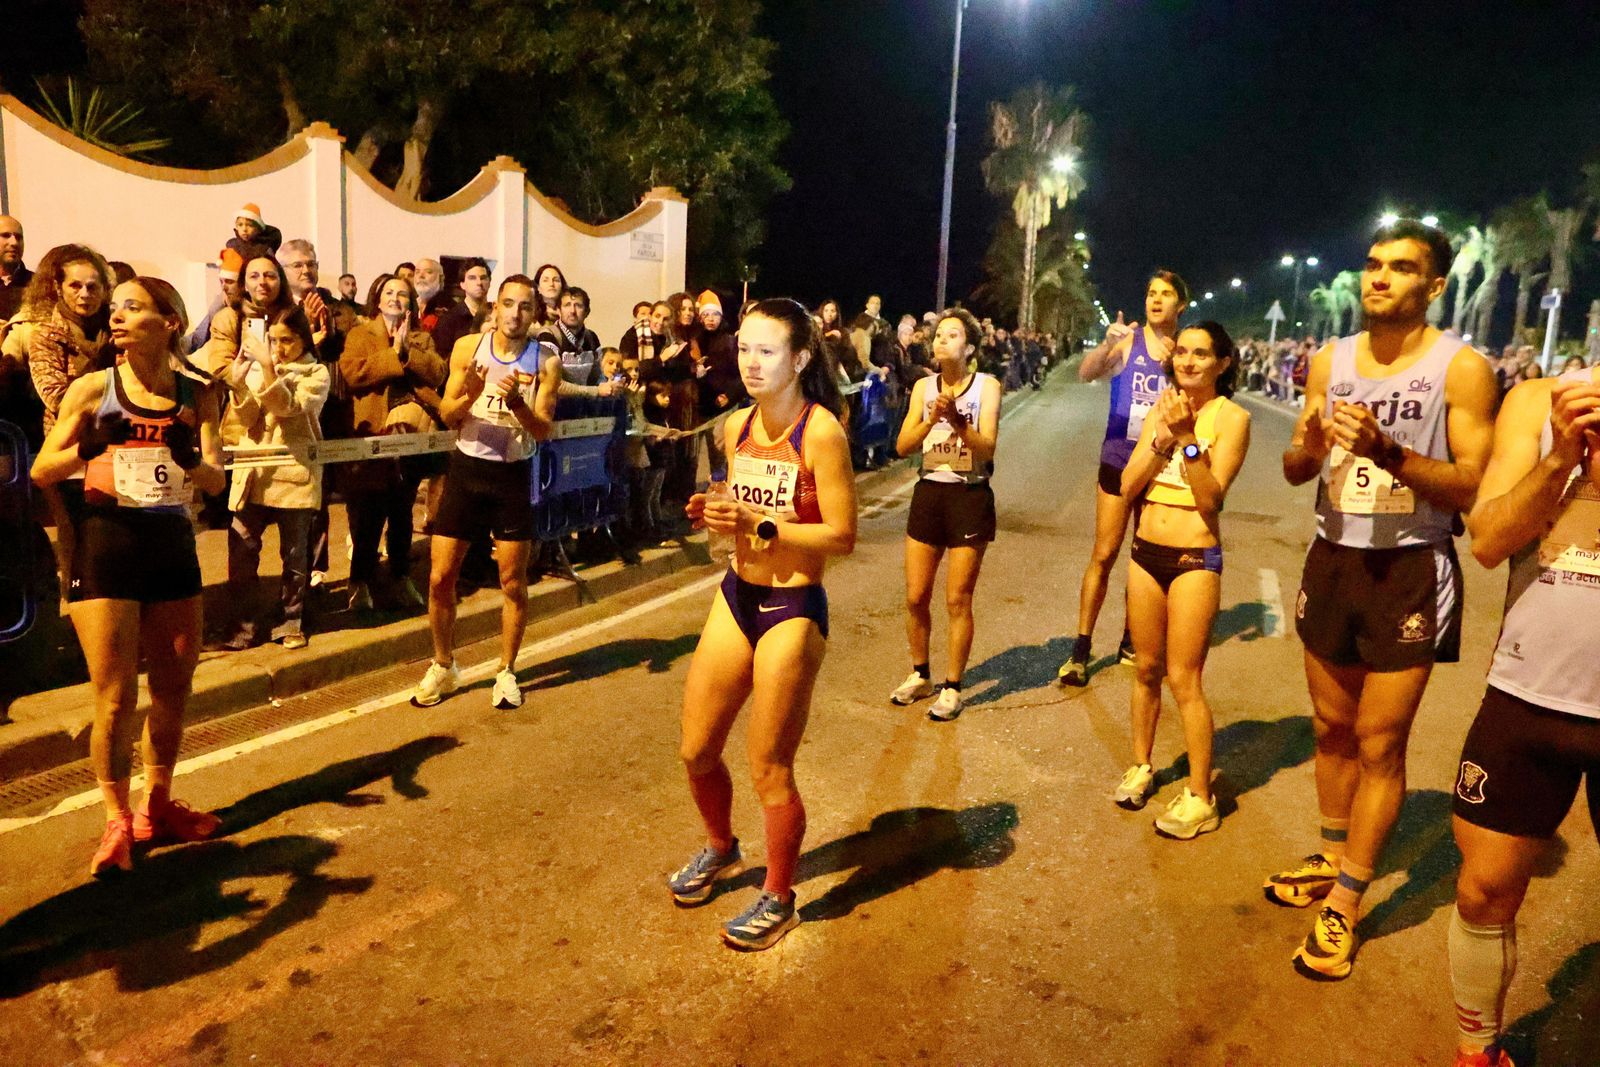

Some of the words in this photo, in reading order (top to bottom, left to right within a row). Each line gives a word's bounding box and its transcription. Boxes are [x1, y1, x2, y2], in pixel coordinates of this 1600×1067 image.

[154, 464, 168, 484] 6
[766, 464, 776, 476] M
[1356, 466, 1370, 488] 5
[732, 483, 774, 507] 1202
[1575, 550, 1600, 561] may
